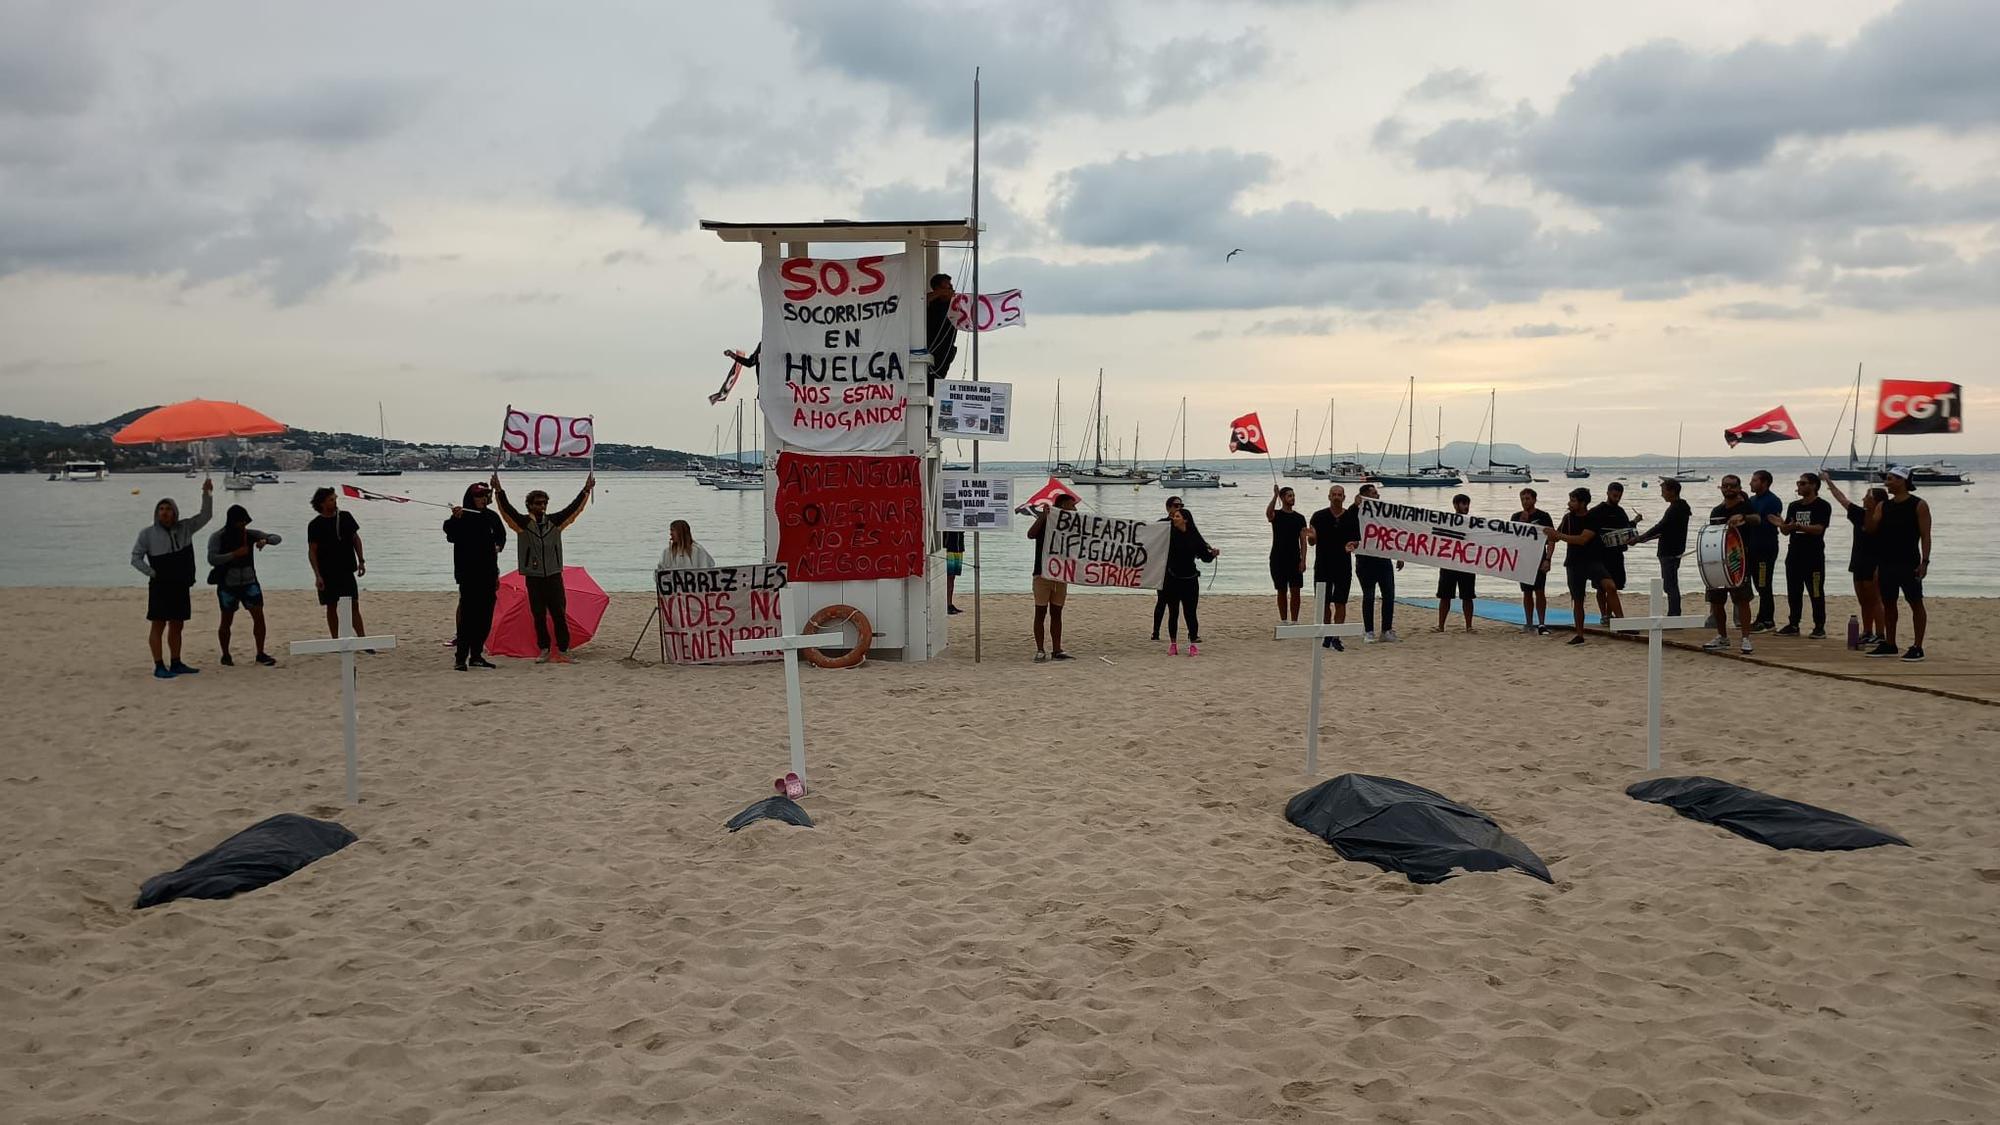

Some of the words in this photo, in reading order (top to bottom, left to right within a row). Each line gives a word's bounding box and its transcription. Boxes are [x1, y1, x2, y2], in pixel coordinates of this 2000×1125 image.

[781, 256, 885, 301] S.O.S
[783, 295, 898, 325] SOCORRISTAS
[825, 328, 860, 348] EN
[785, 351, 904, 384] HUELGA
[843, 383, 894, 404] ESTAN
[958, 384, 978, 392] TIERRA
[1882, 393, 1957, 419] CGT
[958, 489, 973, 497] NOS
[974, 489, 990, 497] PIDE
[962, 480, 969, 488] EL
[971, 480, 987, 488] MAR
[784, 497, 919, 527] GOVERNAR
[1362, 500, 1464, 527] AYUNTAMIENTO
[1469, 516, 1484, 529] DE
[1488, 519, 1538, 541] CALVIA
[808, 529, 842, 550] NO
[1363, 523, 1518, 572] PRECARIZACION
[751, 565, 787, 592] LES
[1048, 557, 1076, 583] ON
[1084, 562, 1144, 587] STRIKE
[664, 628, 734, 661] TENEN
